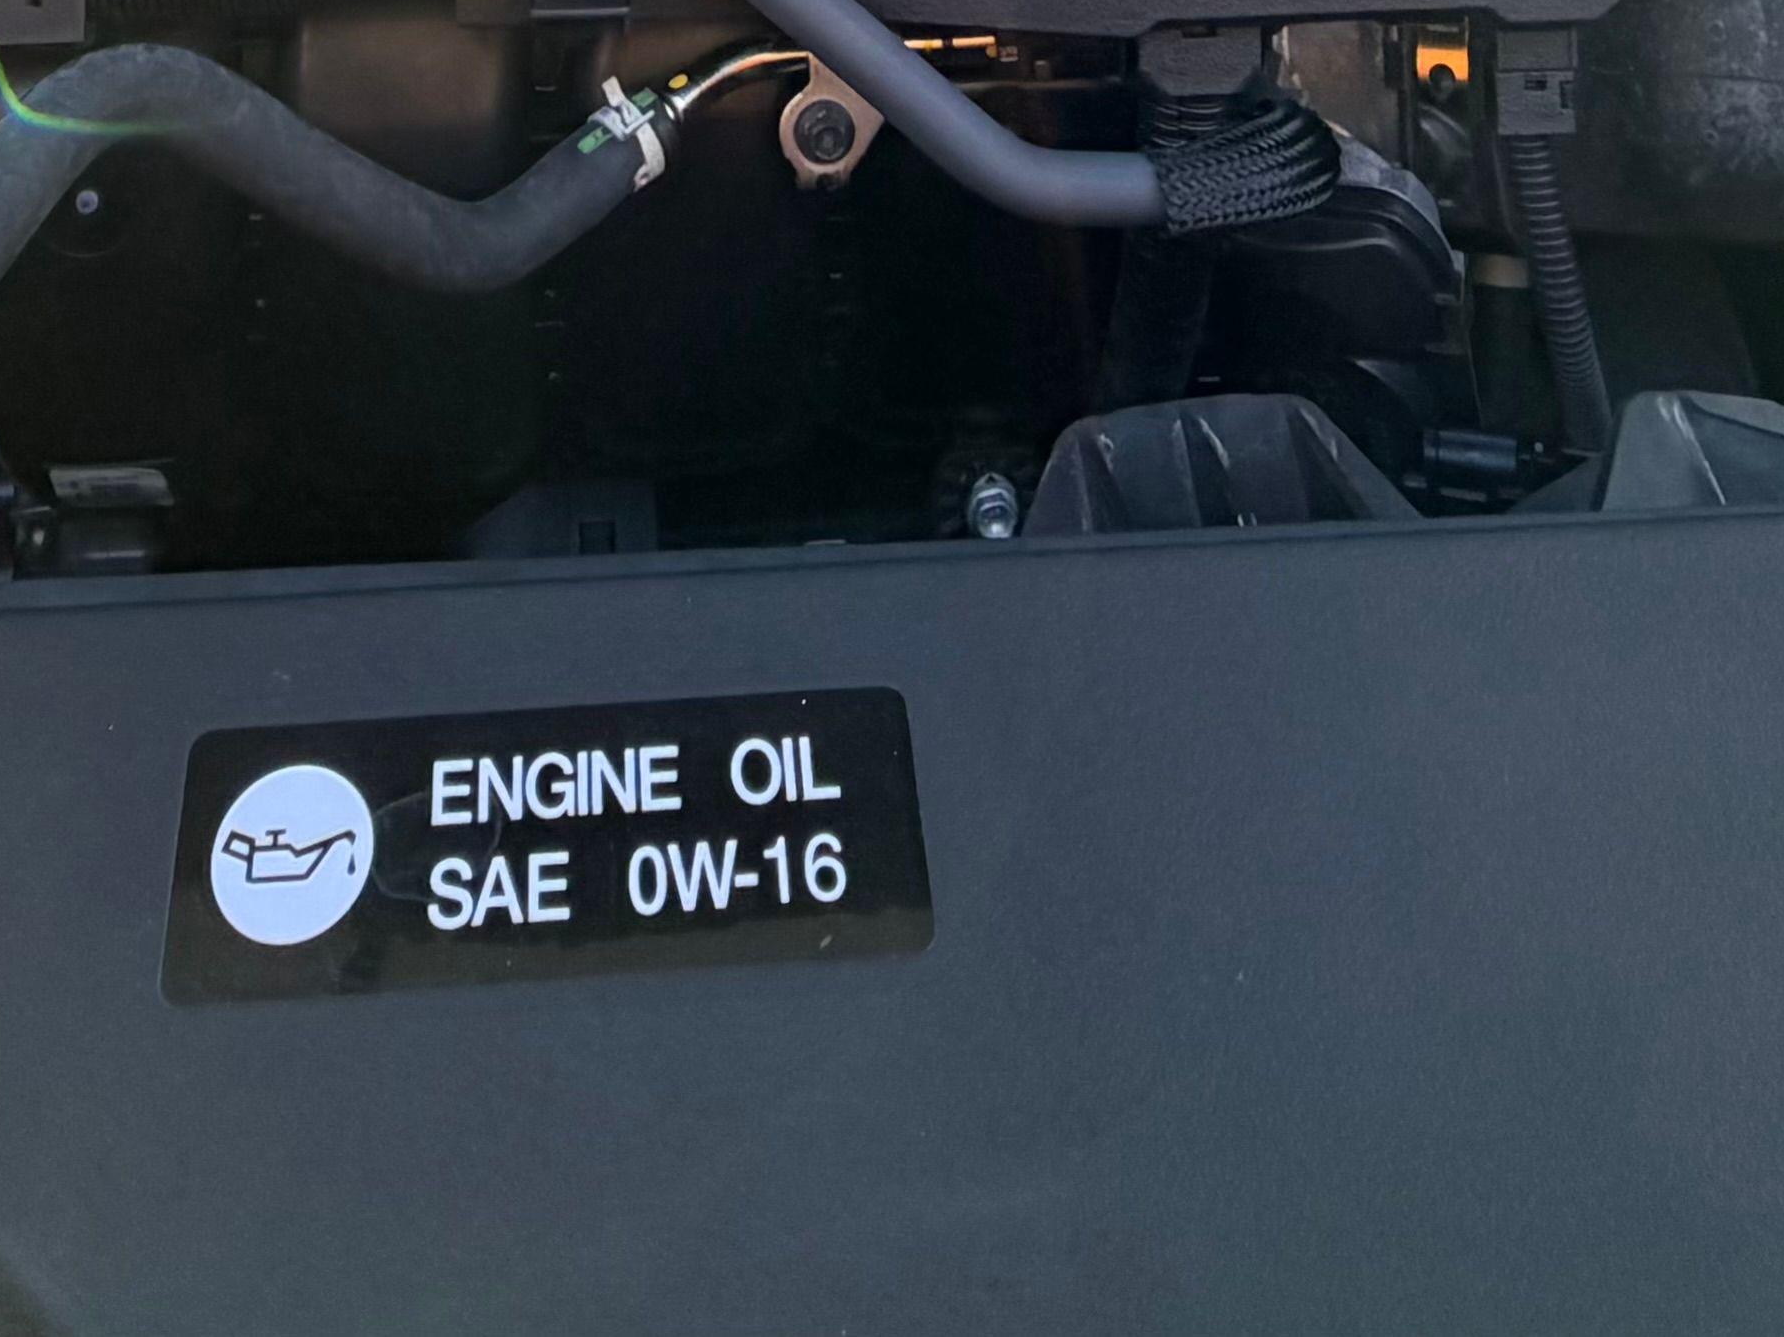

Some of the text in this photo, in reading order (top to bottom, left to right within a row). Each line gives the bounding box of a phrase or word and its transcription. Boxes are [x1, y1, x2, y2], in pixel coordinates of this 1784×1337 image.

[430, 735, 842, 827] ENGINE OIL
[426, 832, 847, 931] SAE 0W-16
